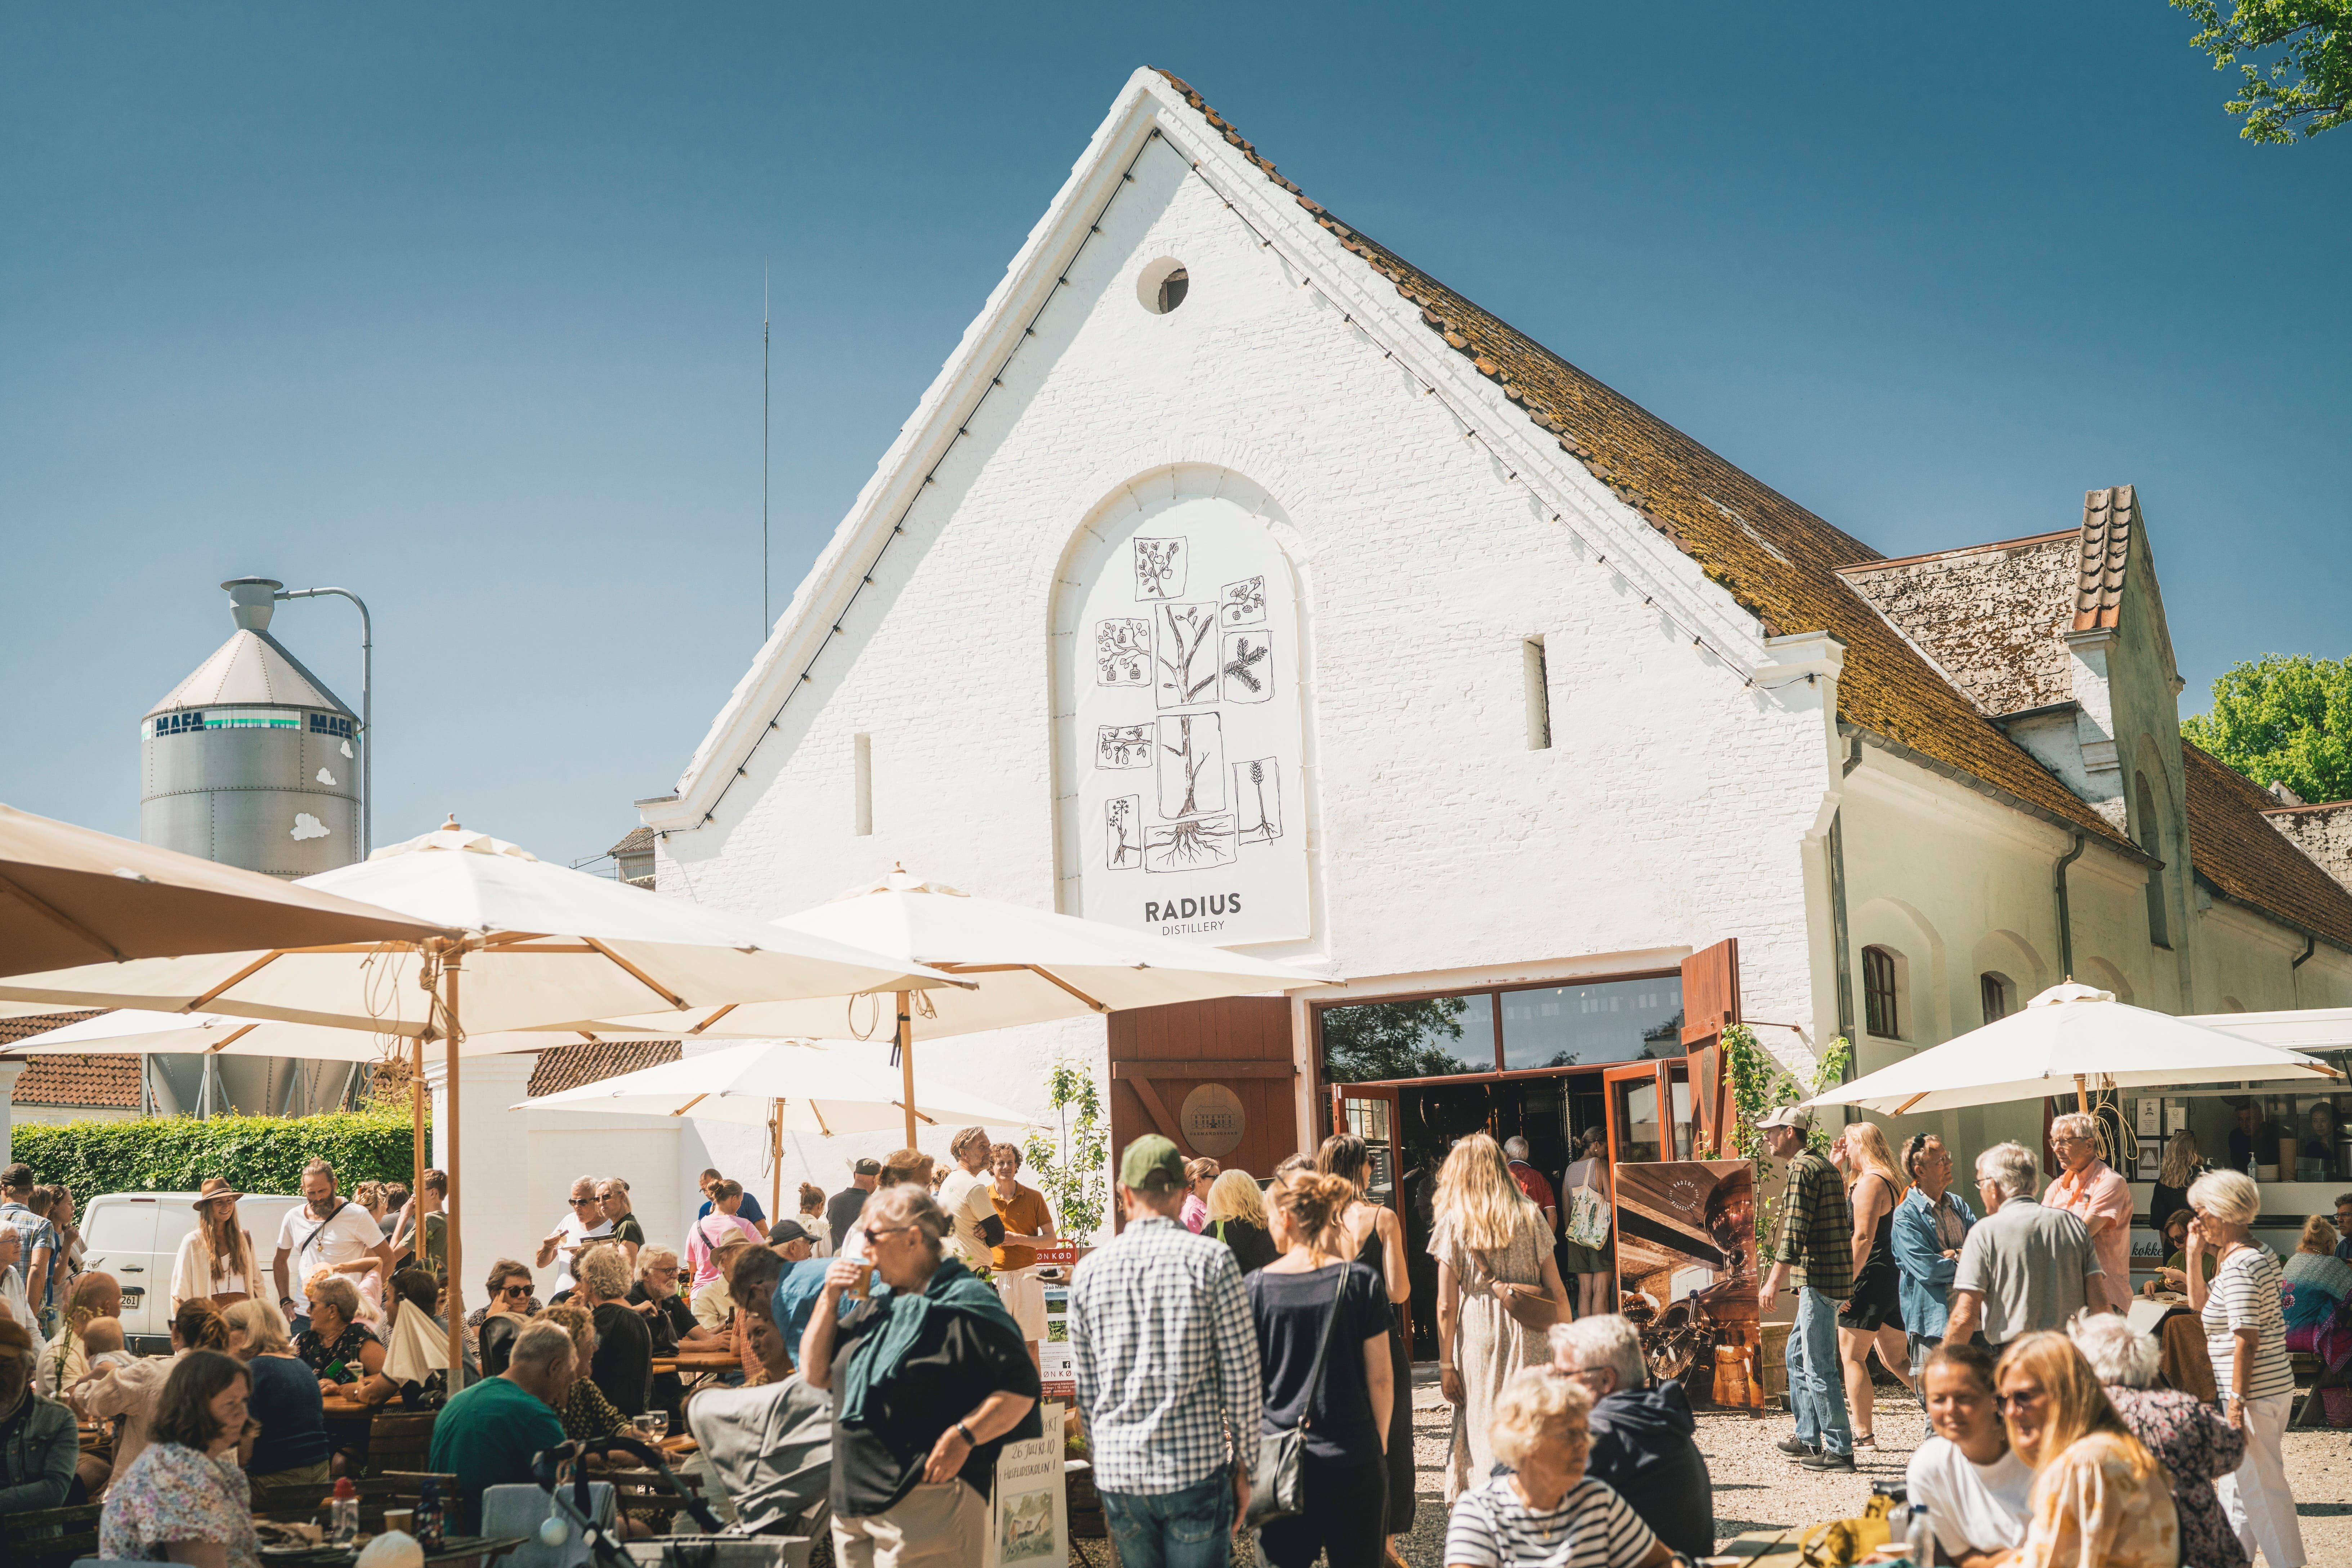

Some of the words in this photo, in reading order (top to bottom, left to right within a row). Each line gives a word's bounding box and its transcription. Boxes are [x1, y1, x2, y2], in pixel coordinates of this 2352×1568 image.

[156, 712, 204, 737] MAFA
[310, 714, 353, 740] MAFA
[1146, 893, 1241, 922] RADIUS
[1163, 921, 1224, 935] DISTILLERY
[1671, 1201, 1697, 1211] DISTILLERY
[2131, 1242, 2163, 1257] køkke
[122, 1296, 135, 1305] 261
[1011, 1443, 1023, 1459] 26
